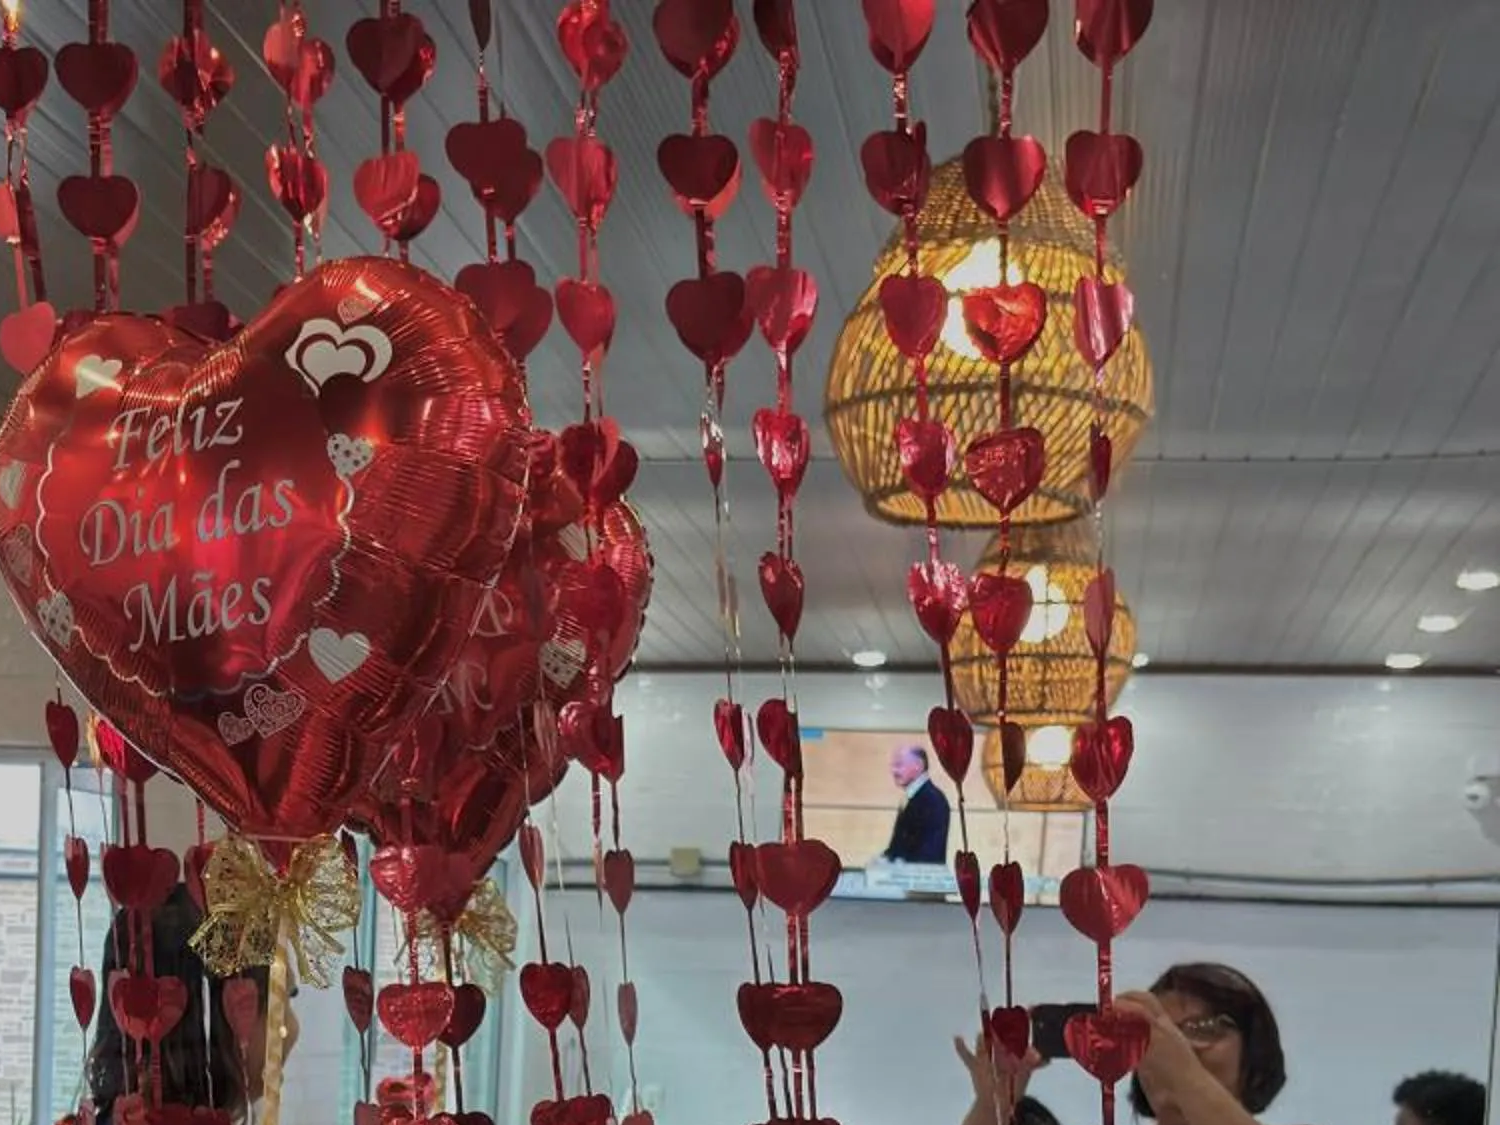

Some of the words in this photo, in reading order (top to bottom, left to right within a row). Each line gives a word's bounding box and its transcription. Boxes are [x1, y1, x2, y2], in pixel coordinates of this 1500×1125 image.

[104, 397, 244, 471] Feliz
[79, 486, 181, 567] Dia
[196, 459, 296, 543] das
[123, 570, 272, 653] Mães
